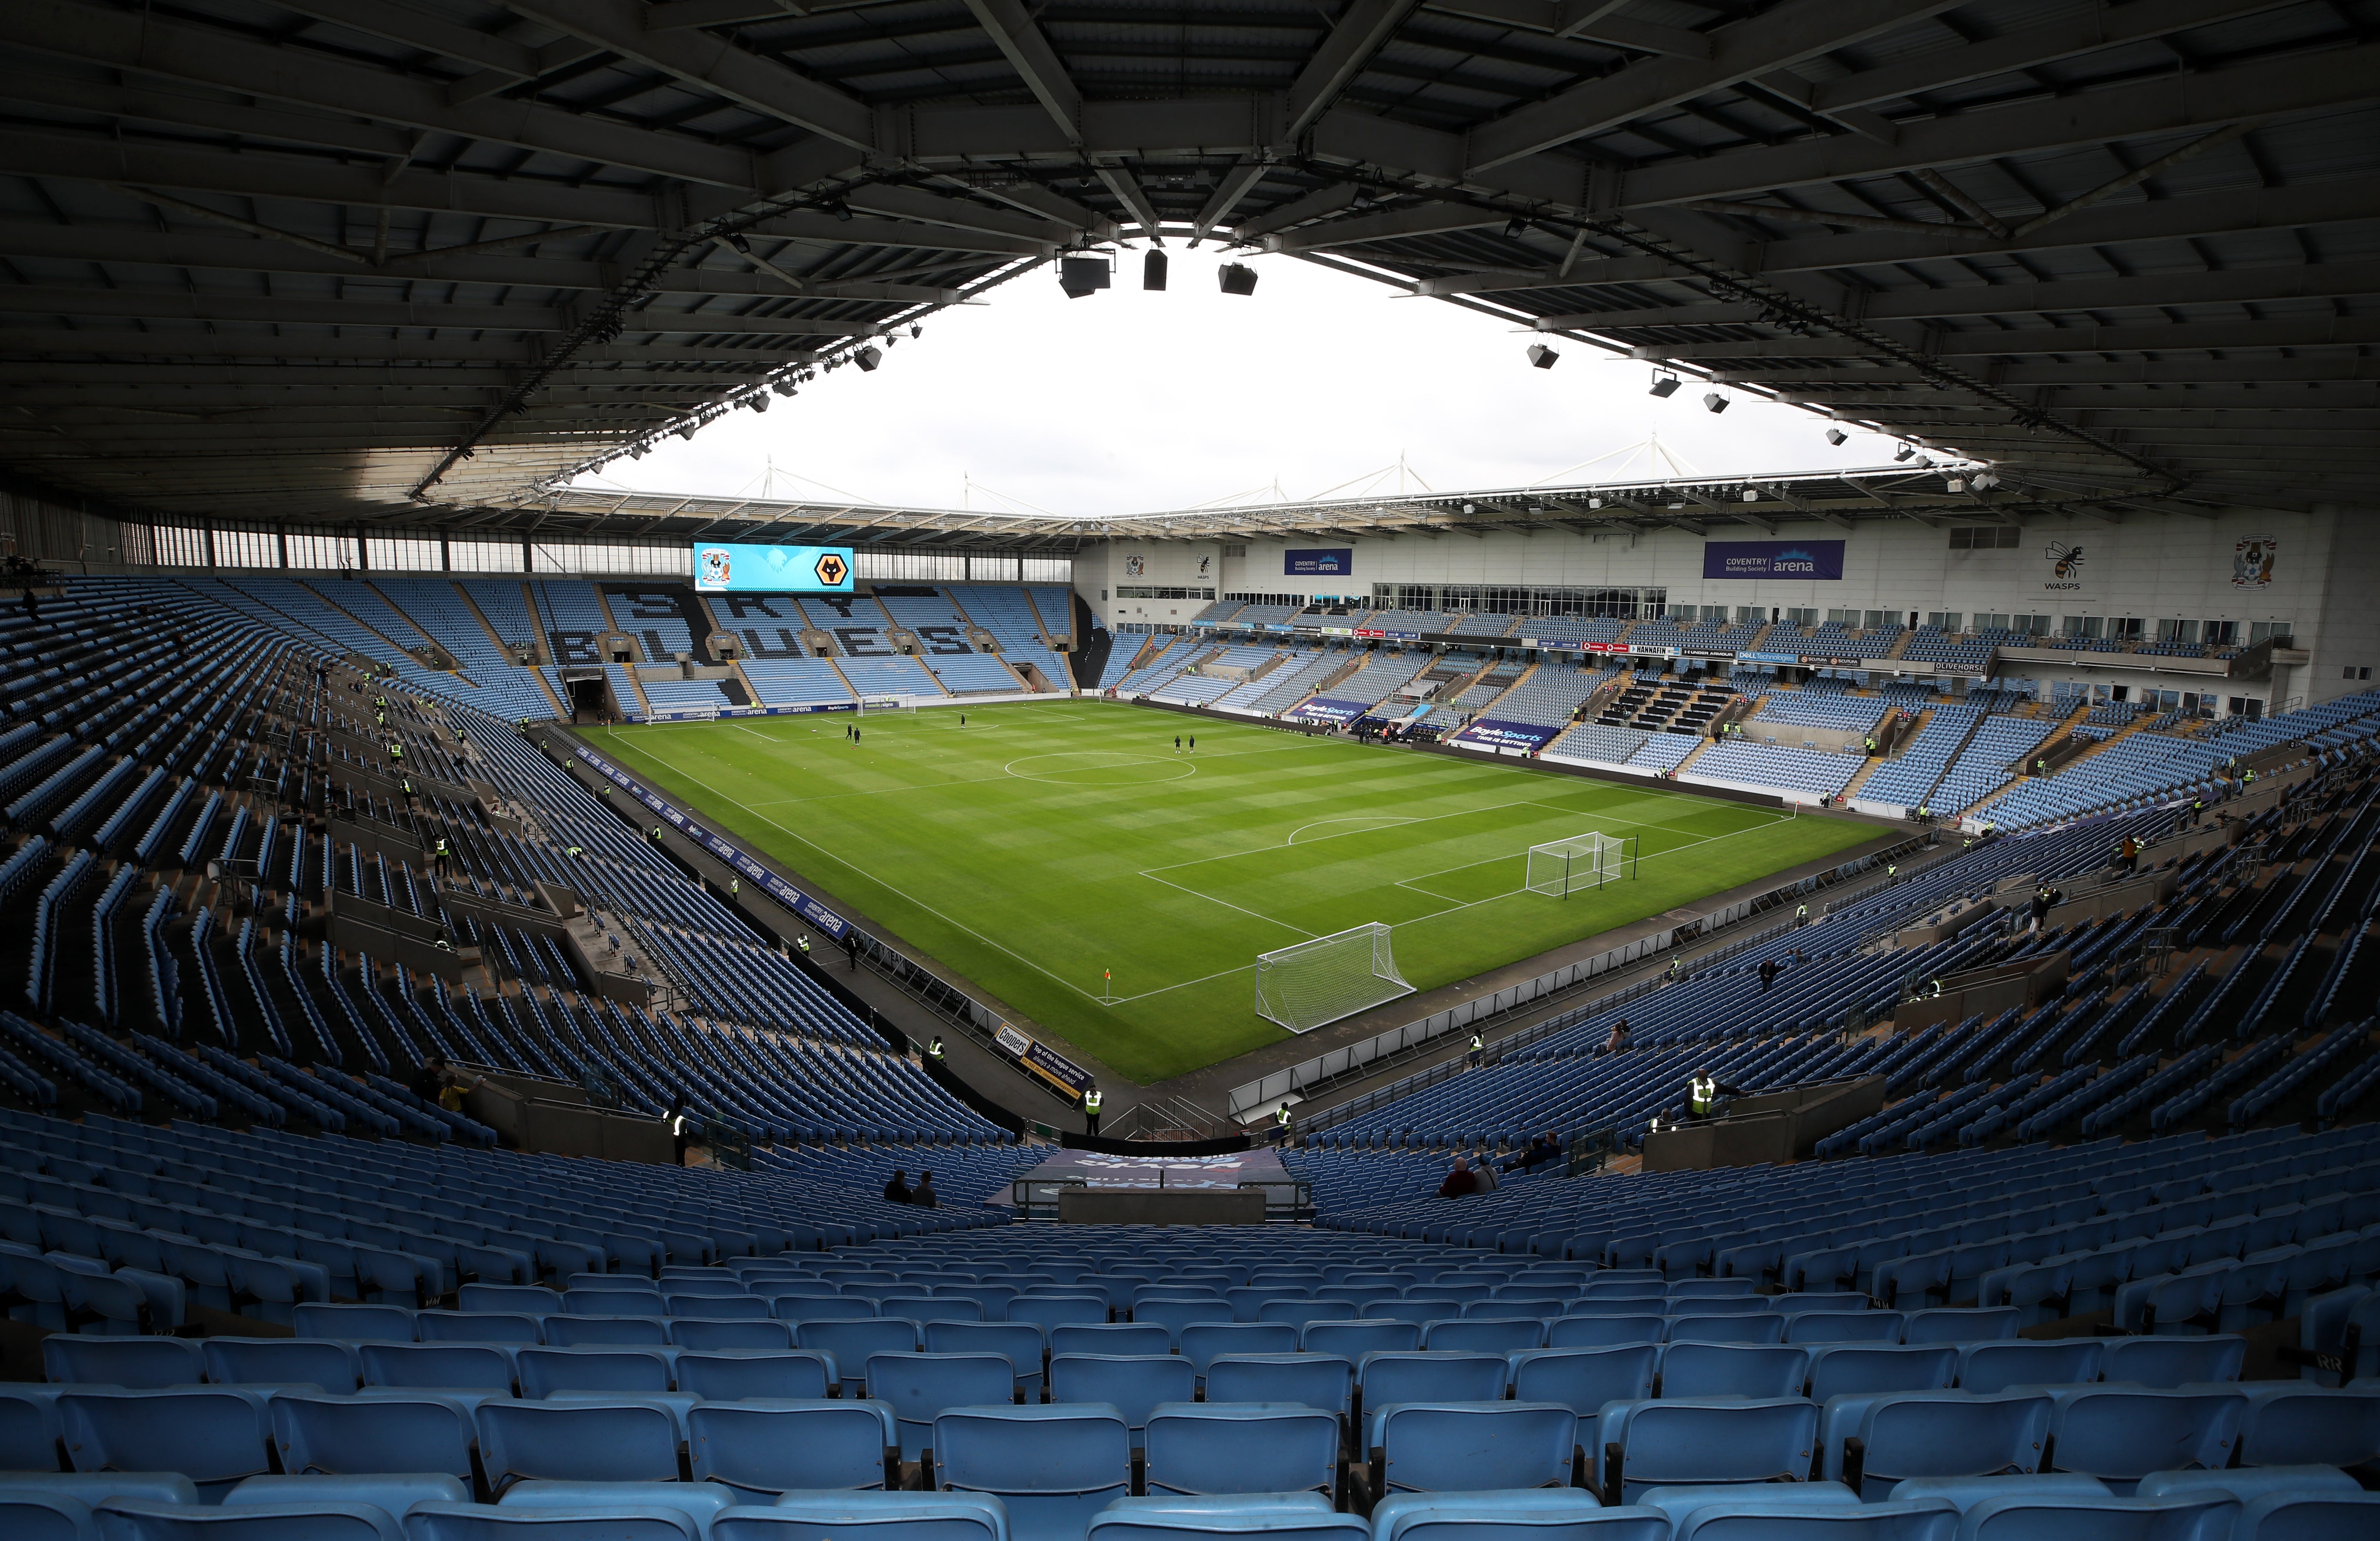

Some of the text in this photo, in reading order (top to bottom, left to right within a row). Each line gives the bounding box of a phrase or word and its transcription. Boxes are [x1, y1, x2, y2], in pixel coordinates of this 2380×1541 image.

[1774, 562, 1814, 572] arena
[549, 626, 975, 665] BLUES
[1637, 646, 1666, 654] HANNAFIN
[1757, 653, 1794, 662] Technologies
[1936, 662, 1984, 671] OLIVEHORSE
[1301, 704, 1357, 716] BoyleSports
[1469, 726, 1543, 742] BoyleSports
[1500, 739, 1532, 747] BETTING
[670, 812, 684, 825] arena
[718, 843, 735, 859] arena
[739, 856, 751, 865] COVENTRY
[747, 863, 765, 880] arena
[770, 877, 783, 888] COVENTRY
[779, 886, 800, 904] arena
[807, 902, 822, 914] COVENTRY
[819, 911, 843, 933] arena
[1685, 922, 1696, 932] FREE
[999, 1028, 1026, 1053] Coopers
[1033, 1055, 1046, 1069] always
[1050, 1066, 1062, 1076] move
[1061, 1071, 1076, 1085] ahead
[1054, 1057, 1069, 1070] league
[1068, 1066, 1085, 1080] service
